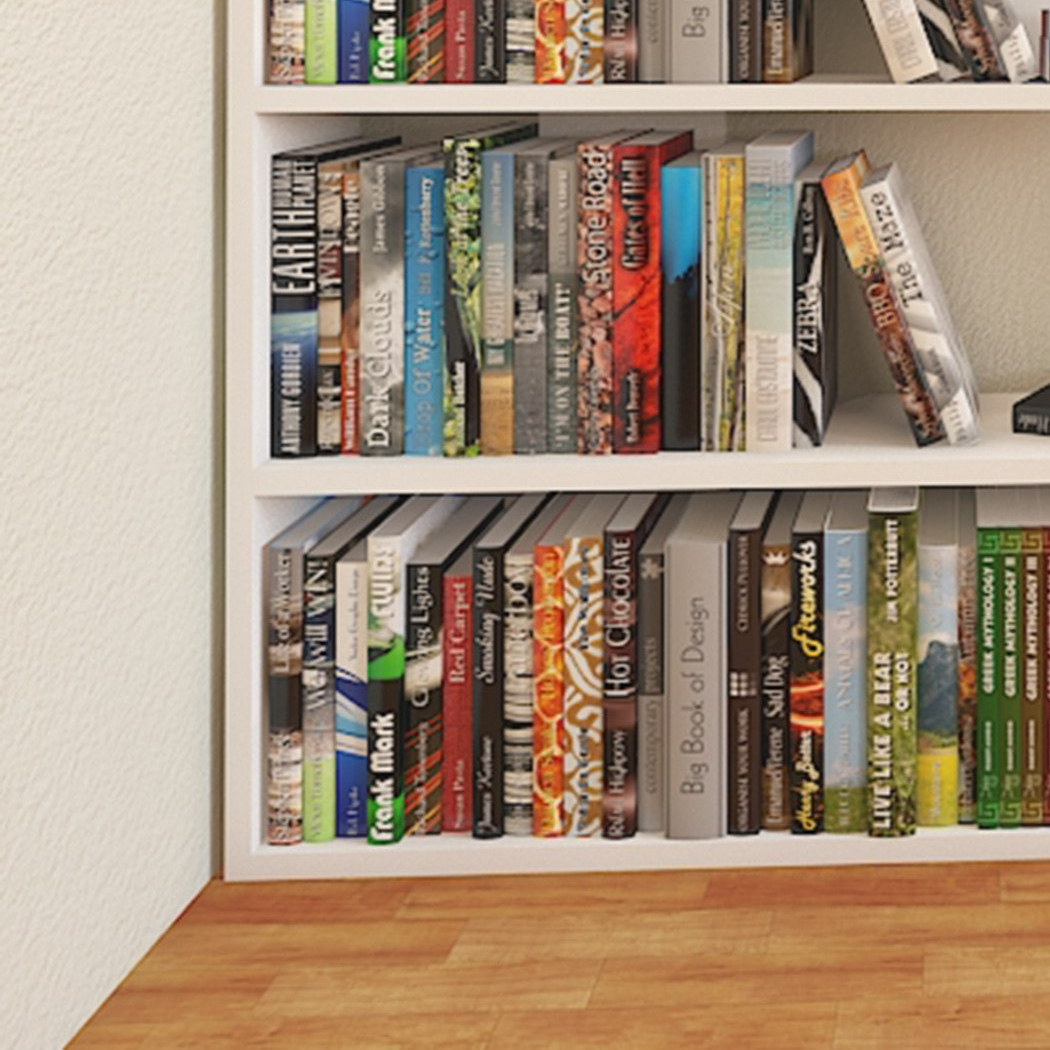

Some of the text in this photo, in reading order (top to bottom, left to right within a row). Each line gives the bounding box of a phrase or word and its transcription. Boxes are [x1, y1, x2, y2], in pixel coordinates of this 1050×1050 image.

[373, 18, 397, 80] Frank
[681, 5, 710, 40] Big
[272, 210, 315, 294] EARTH
[581, 151, 608, 282] Stone Road
[870, 190, 924, 309] The Maze
[412, 308, 431, 364] Water
[796, 281, 821, 353] ZEBRA
[366, 290, 391, 448] Dark Clouds
[555, 344, 571, 380] THE
[409, 567, 433, 624] Lights
[448, 582, 470, 684] Red Carpet
[604, 537, 637, 698] HOT CHOCOLATE
[791, 541, 823, 658] Fireworks
[982, 567, 994, 648] MYTHOLOGY
[1004, 570, 1016, 652] MYTHOLOGY
[1026, 574, 1038, 655] MYTHOLOGY
[679, 596, 709, 796] Big Book of Design
[895, 652, 910, 685] NOT
[982, 652, 994, 693] GREEK
[1004, 655, 1016, 697] GREEK
[1026, 659, 1038, 700] GREEK
[370, 713, 395, 841] Frank Mark
[873, 652, 891, 830] LIVE LIKE A BEAR
